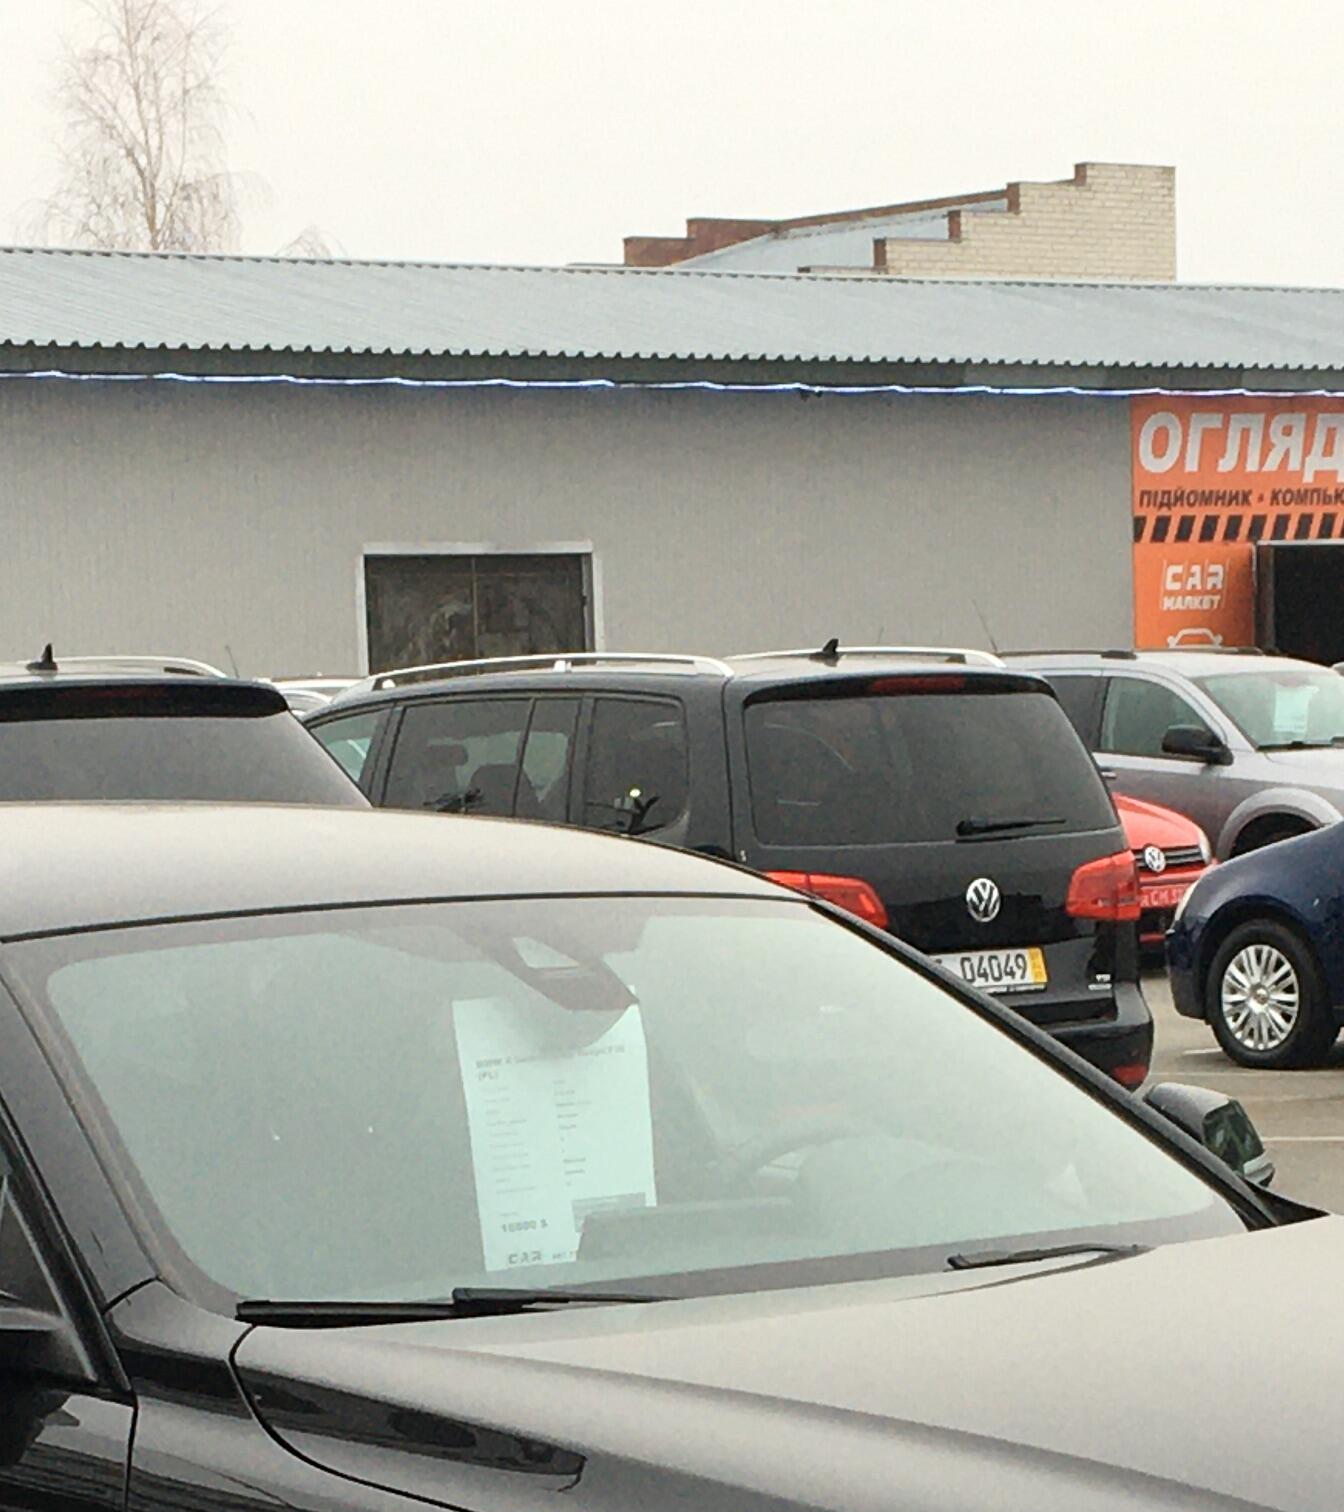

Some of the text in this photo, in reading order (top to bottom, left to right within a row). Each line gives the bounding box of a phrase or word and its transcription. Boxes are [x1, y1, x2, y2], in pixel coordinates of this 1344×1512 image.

[1139, 486, 1253, 511] ПІДЙОМНИК
[1165, 563, 1224, 591] CAR
[1162, 594, 1221, 611] MARKET
[960, 953, 1027, 983] 04049
